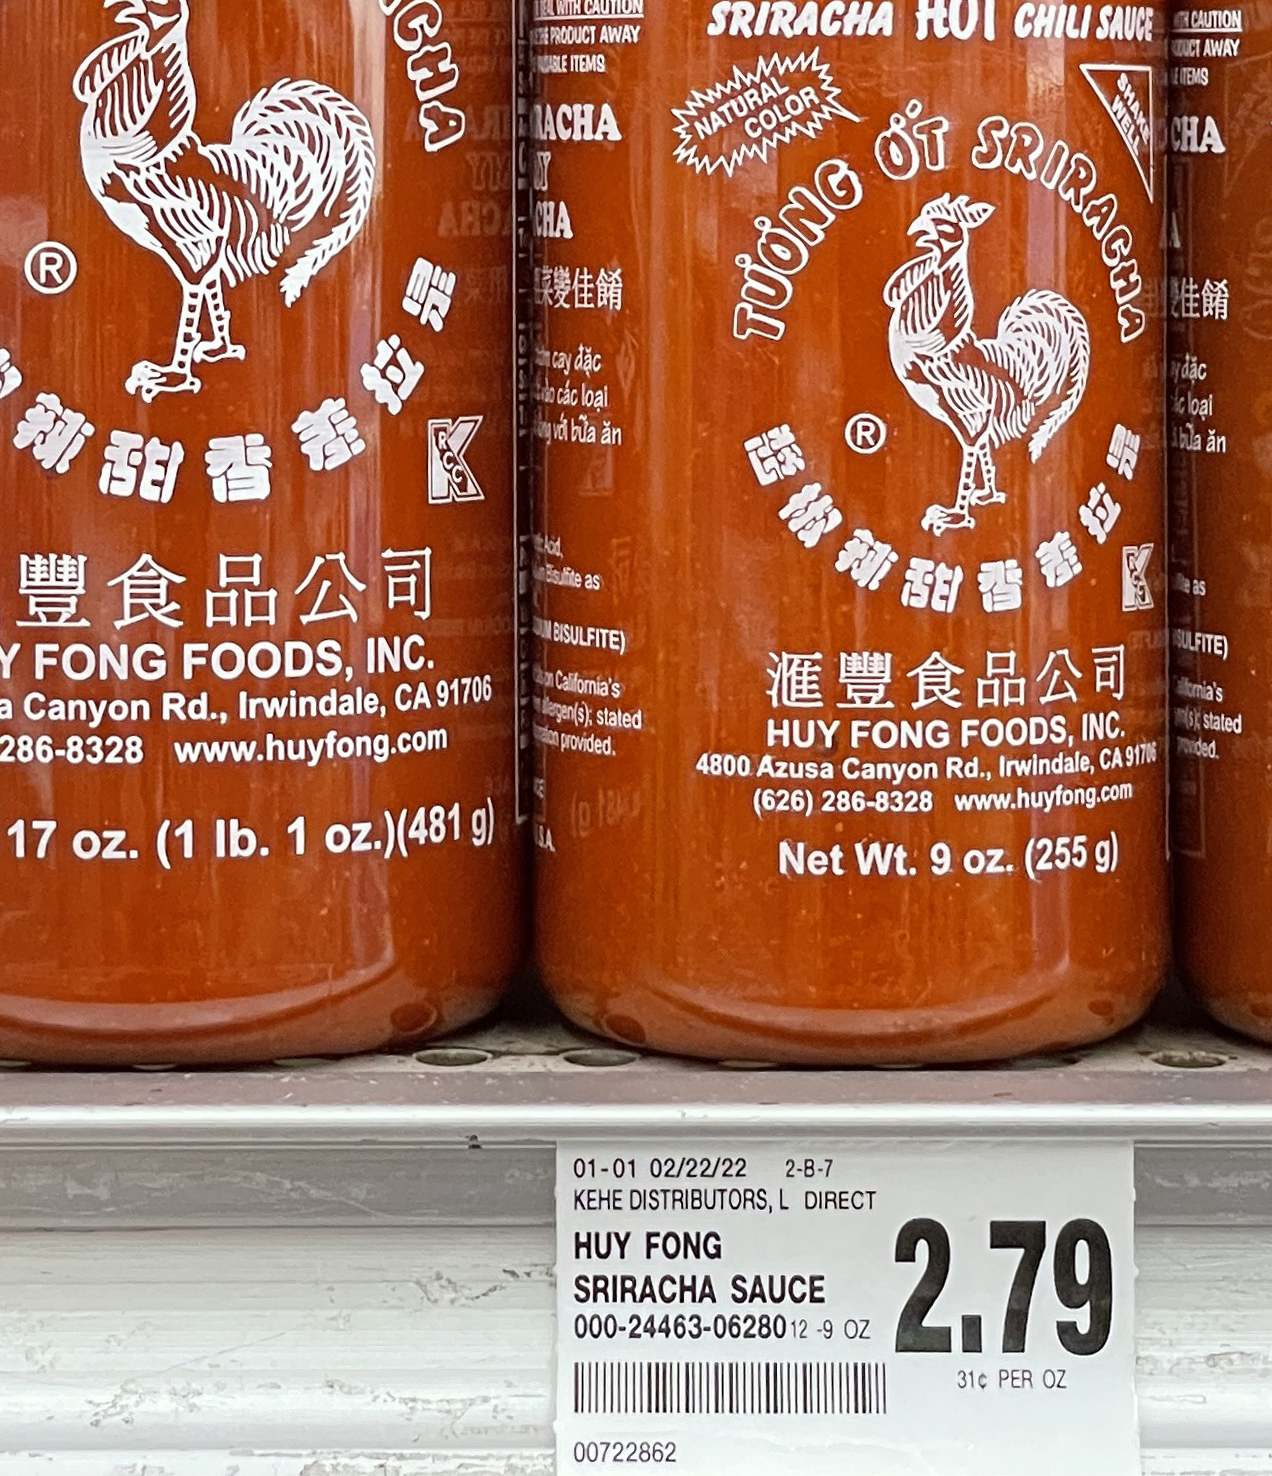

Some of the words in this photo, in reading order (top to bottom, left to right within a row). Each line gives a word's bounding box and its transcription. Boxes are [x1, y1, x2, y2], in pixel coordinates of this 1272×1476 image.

[707, 0, 894, 37] SRIRACHA
[1014, 3, 1092, 39] CHILI
[1096, 4, 1153, 42] SAUCE
[599, 25, 641, 43] AWAY
[570, 54, 605, 72] ITEMS
[24, 694, 150, 729] Canyon
[160, 693, 229, 726] Rd.,
[238, 685, 387, 722] Irwindale,
[395, 681, 430, 711] CA
[437, 675, 492, 706] 91706
[597, 707, 641, 729] stated
[561, 734, 616, 756] provided.
[752, 788, 813, 817] (626)
[820, 790, 932, 812] 286-8328
[954, 780, 1132, 812] www.huyfong.com
[778, 842, 842, 875] Net
[855, 842, 915, 875] Wt.
[930, 842, 950, 875] 9
[962, 849, 1014, 875] oz.
[1025, 837, 1085, 879] (255
[1094, 832, 1119, 871] g)
[573, 1158, 637, 1179] 01-01
[650, 1158, 747, 1178] 02/22/22
[785, 1159, 834, 1178] 2-B-7
[574, 1189, 623, 1210] KEHE
[630, 1189, 774, 1213] DISTRIBUTORS,
[779, 1189, 789, 1210] L
[805, 1191, 876, 1210] DIRECT
[574, 1231, 632, 1259] HUY
[645, 1231, 722, 1260] FONG
[574, 1275, 716, 1304] SRIRACHA
[731, 1275, 825, 1304] SAUCE
[895, 1218, 1113, 1355] 2.79
[574, 1315, 786, 1340] 000-24463-06280
[790, 1320, 807, 1339] 12
[816, 1320, 834, 1339] -9
[844, 1320, 871, 1339] OZ
[958, 1370, 988, 1390] 31¢
[999, 1370, 1033, 1389] PER
[1043, 1370, 1067, 1390] OZ
[574, 1443, 677, 1463] 00722862
